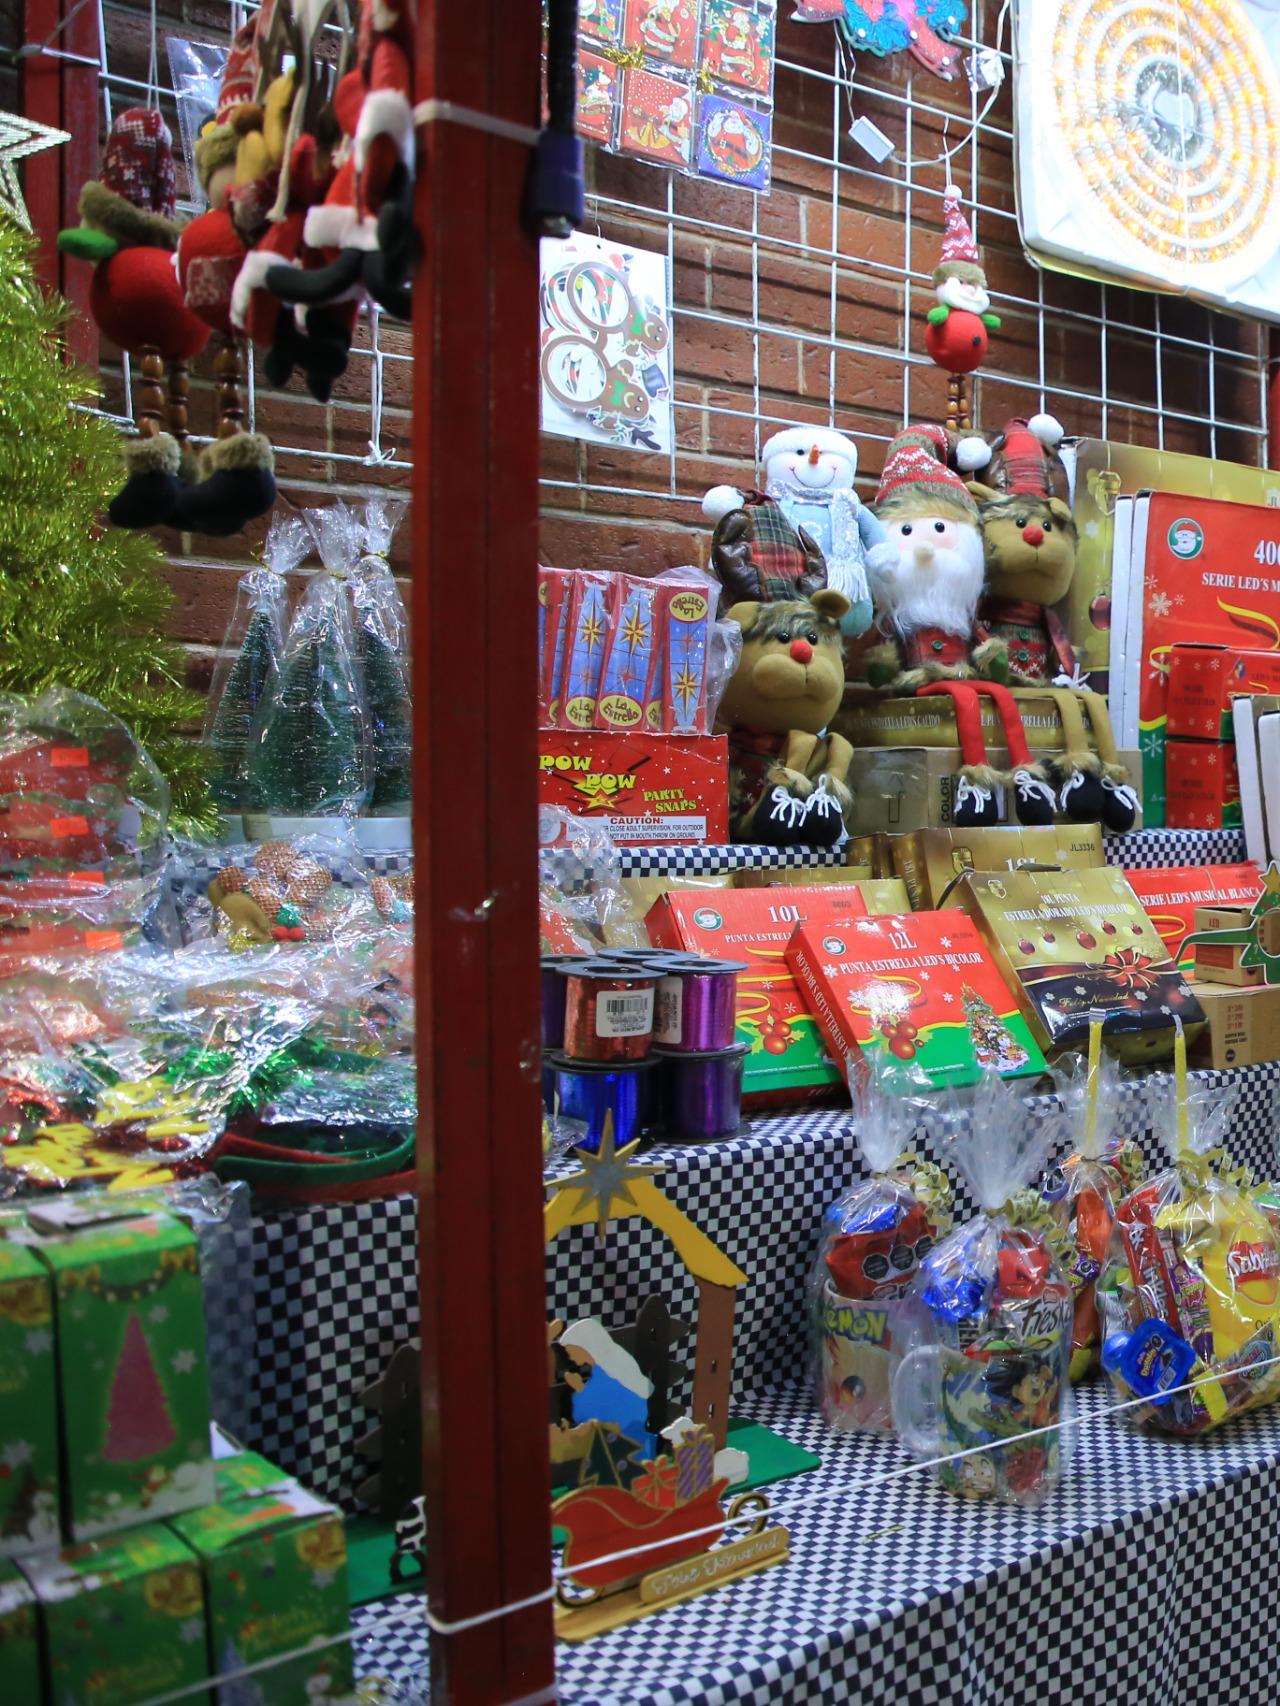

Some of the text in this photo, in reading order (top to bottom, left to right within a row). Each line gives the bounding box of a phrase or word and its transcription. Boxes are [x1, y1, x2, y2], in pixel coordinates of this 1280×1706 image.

[1202, 572, 1236, 588] SERIE
[615, 698, 627, 711] La
[602, 704, 639, 722] Estrella
[539, 755, 592, 771] POW
[585, 773, 637, 790] POW
[643, 788, 685, 802] PARTY
[940, 776, 950, 823] COLOR
[655, 800, 697, 813] SNAPS
[610, 817, 664, 825] CAUTION:
[1139, 893, 1166, 907] SERIE
[1190, 888, 1229, 903] MUSICAL
[724, 933, 756, 943] PUNTA
[888, 930, 917, 950] 12L
[839, 961, 873, 975] PUNTA
[873, 957, 922, 971] ESTRELLA
[945, 952, 984, 966] BICOLOR
